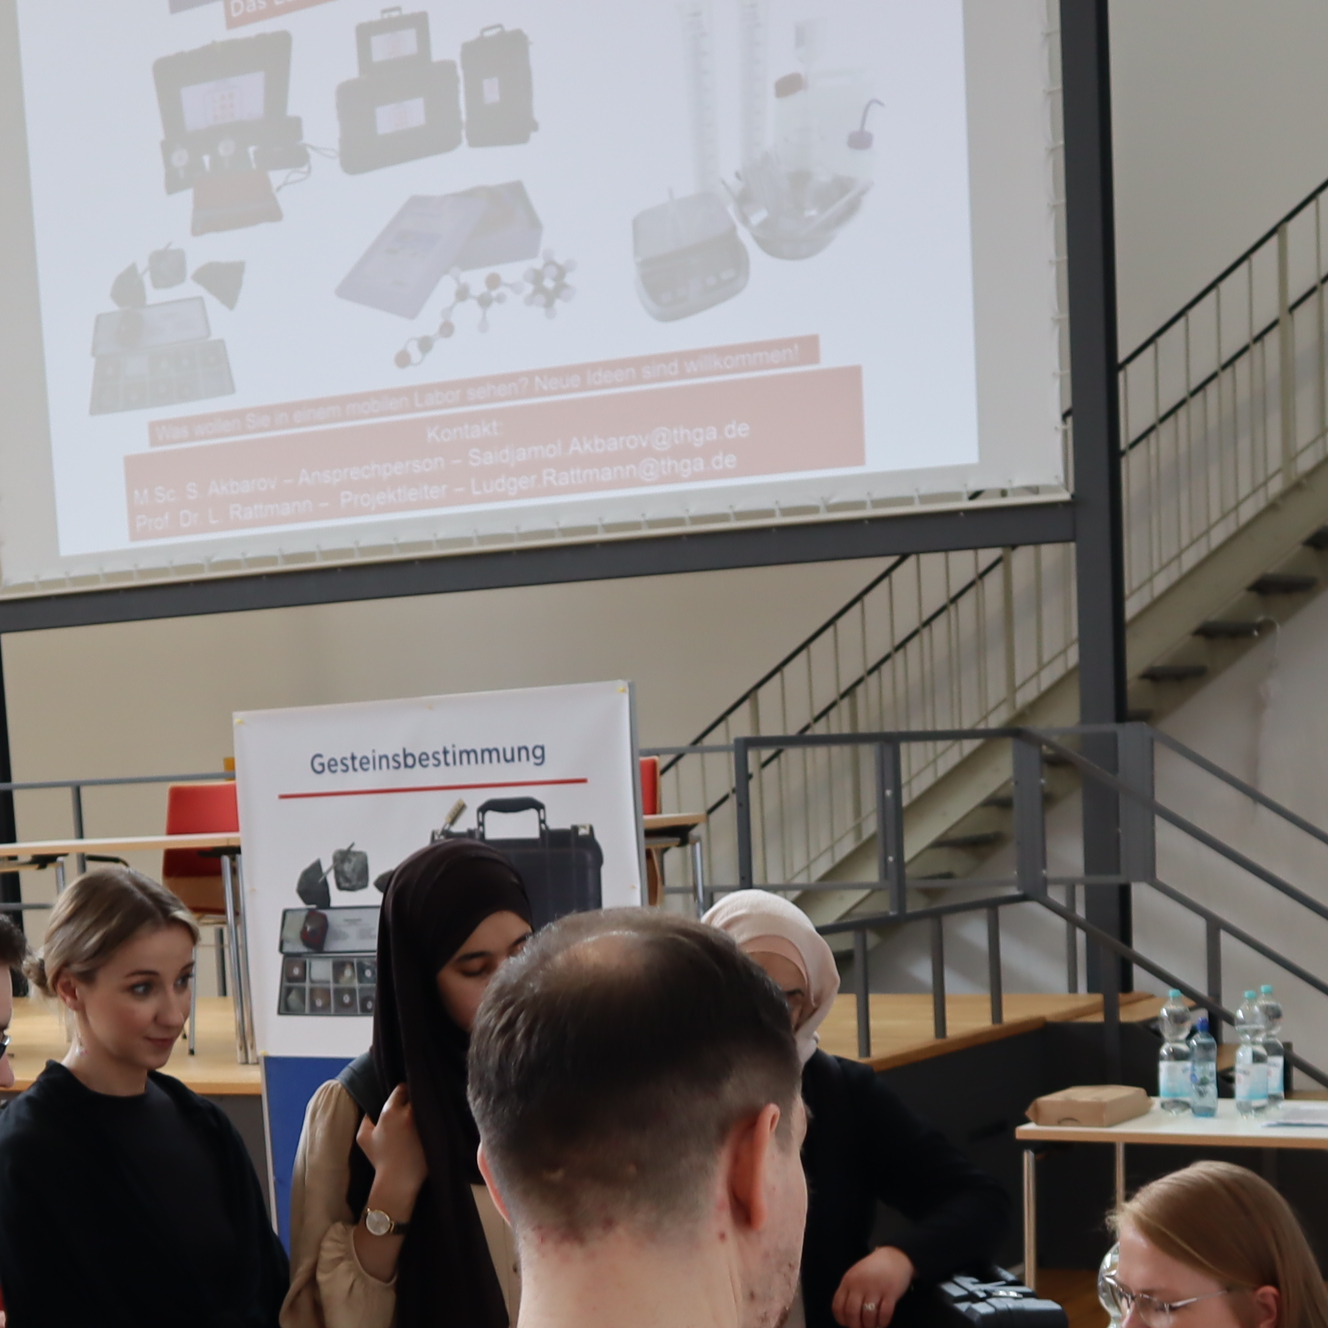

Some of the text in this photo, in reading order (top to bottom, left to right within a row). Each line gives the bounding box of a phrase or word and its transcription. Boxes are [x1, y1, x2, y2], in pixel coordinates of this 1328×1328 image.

[245, 411, 271, 430] Sie
[274, 409, 290, 427] in
[292, 404, 342, 424] einem
[414, 387, 462, 408] Labor
[466, 376, 529, 400] sehen?
[534, 373, 581, 392] Neue
[586, 367, 637, 387] Ideen
[641, 358, 679, 380] sind
[684, 343, 800, 375] willkommen!
[207, 475, 278, 497] Akbarov
[298, 454, 445, 486] Ansprechperson
[229, 498, 314, 522] Rattmann
[339, 482, 448, 511] Projektleiter
[310, 744, 547, 775] Gesteinsbestimmung
